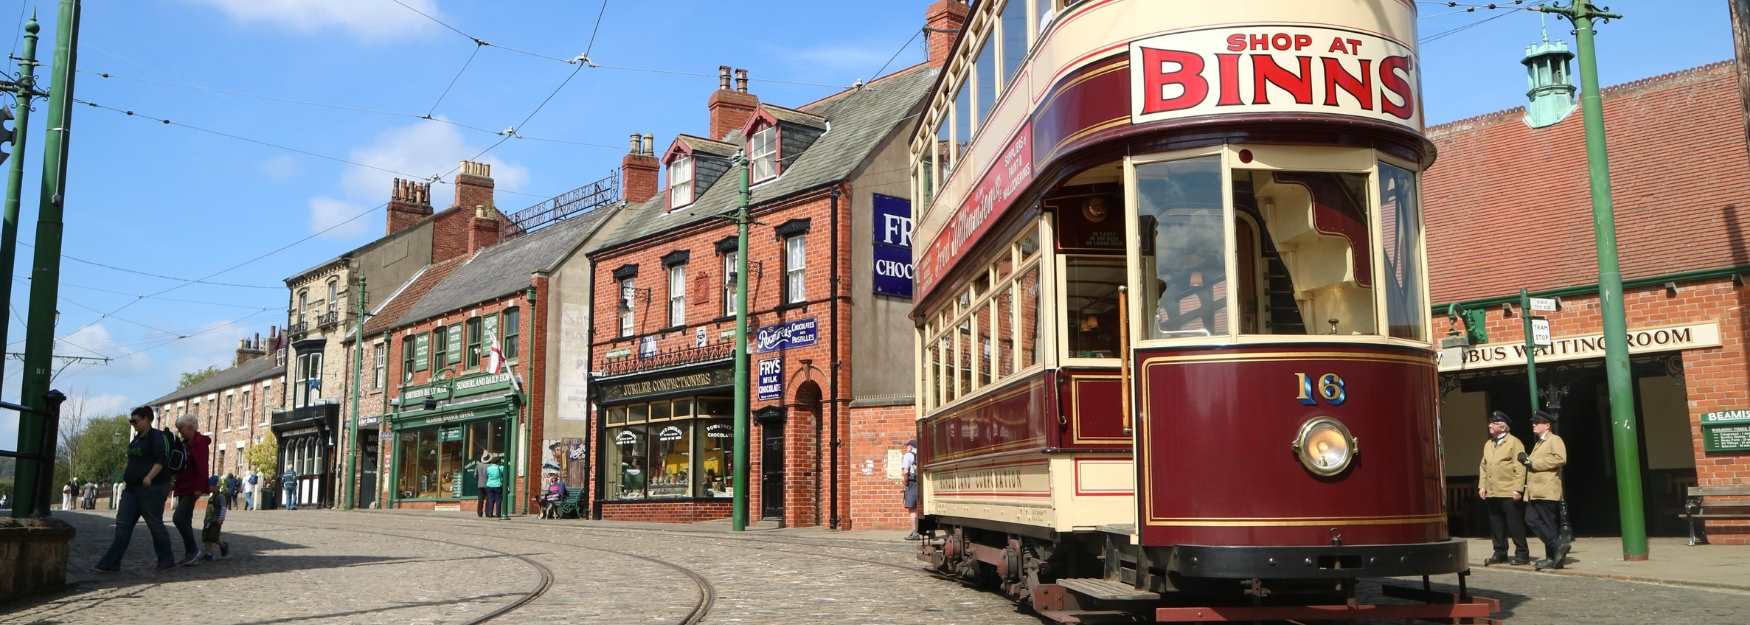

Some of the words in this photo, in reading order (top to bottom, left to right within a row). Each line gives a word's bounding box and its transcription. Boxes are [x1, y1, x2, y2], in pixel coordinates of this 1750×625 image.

[1226, 33, 1313, 52] SHOP
[1328, 36, 1363, 56] AT
[1468, 346, 1506, 364] BUS
[623, 381, 652, 396] JUBILEE
[653, 373, 711, 392] CONFECTIONERS
[763, 375, 778, 384] MILK
[1294, 372, 1346, 405] 16
